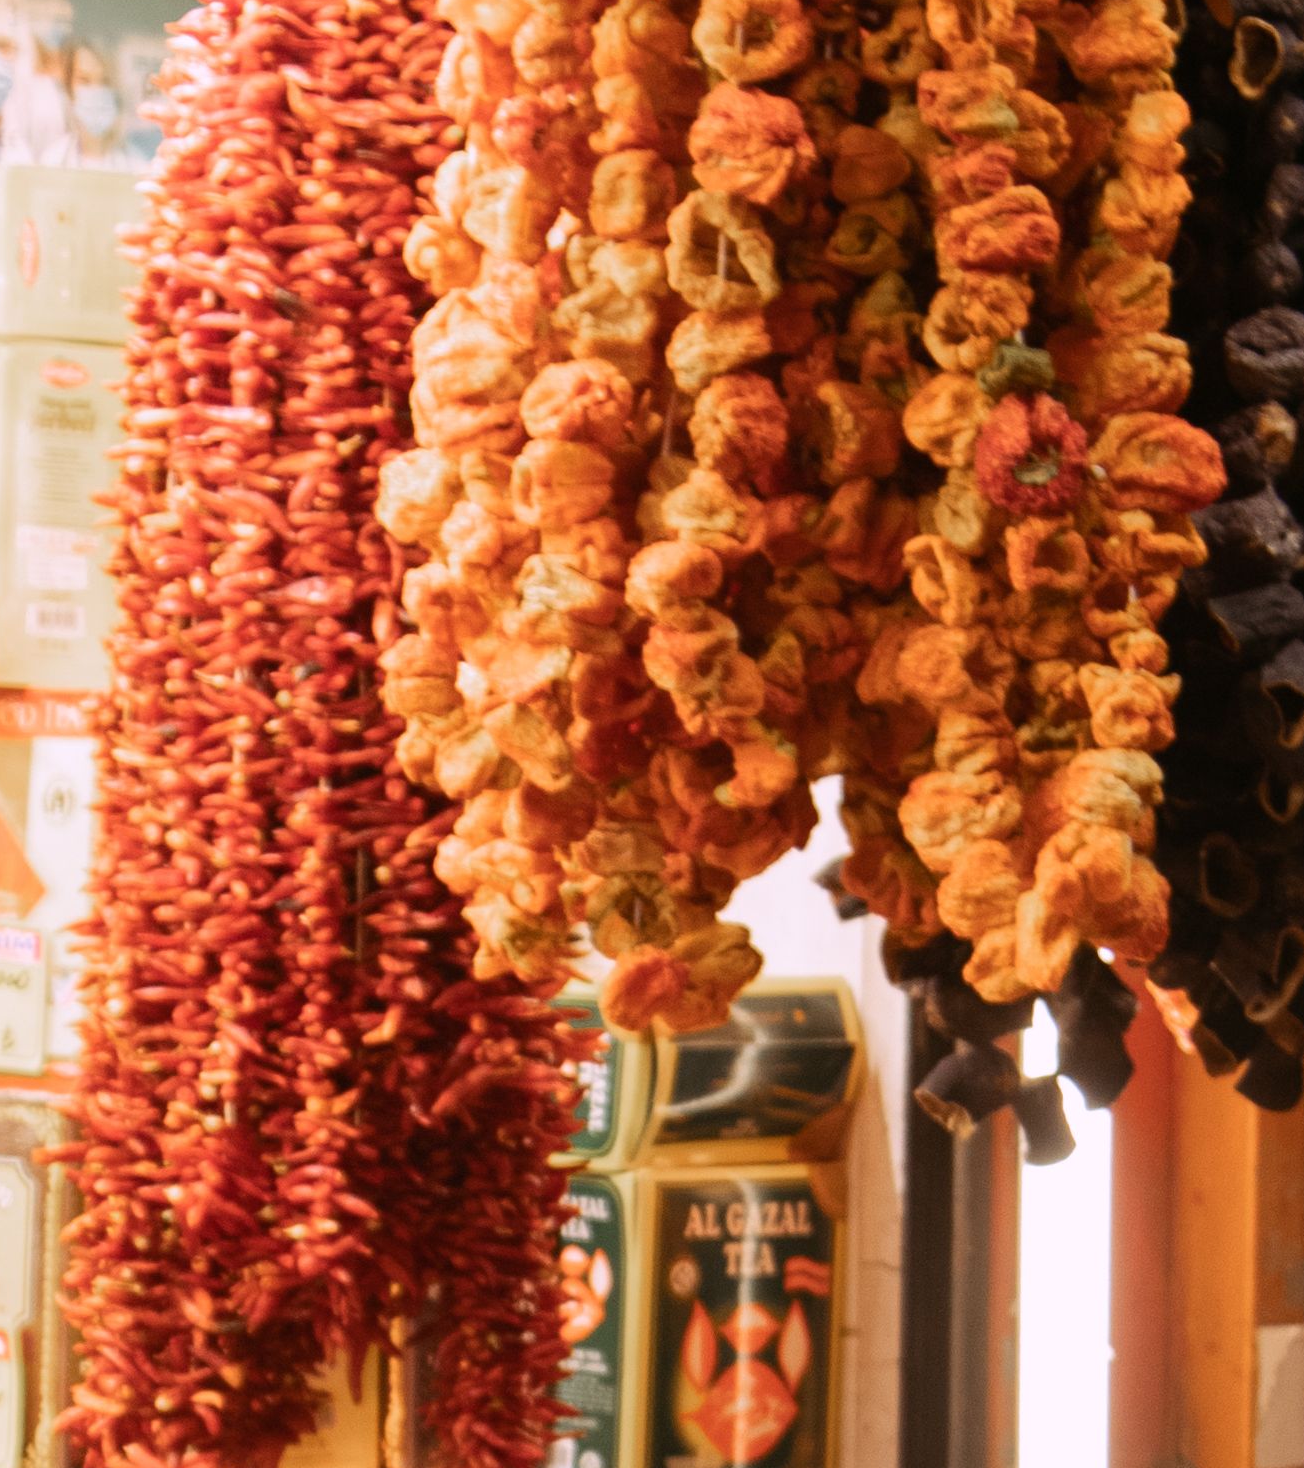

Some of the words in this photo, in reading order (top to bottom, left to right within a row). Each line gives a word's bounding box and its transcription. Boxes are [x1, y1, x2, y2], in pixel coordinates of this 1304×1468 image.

[684, 1203, 721, 1240] AL
[725, 1199, 813, 1237] GAZAL
[722, 1240, 776, 1280] TEA
